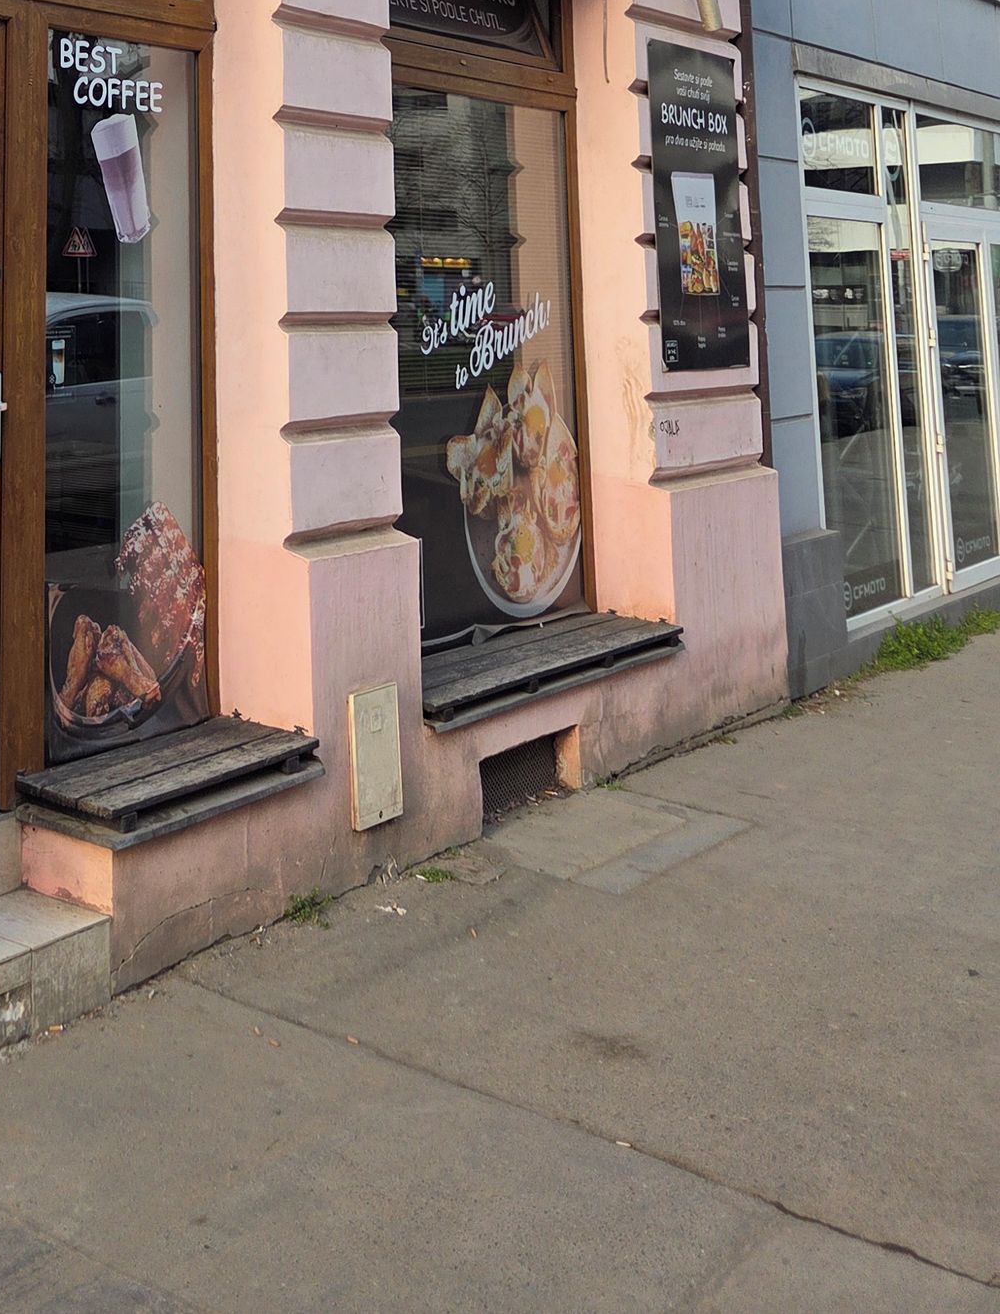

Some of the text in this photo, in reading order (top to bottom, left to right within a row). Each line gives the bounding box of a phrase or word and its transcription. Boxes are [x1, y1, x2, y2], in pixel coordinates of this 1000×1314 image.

[433, 0, 468, 22] PODLE
[60, 38, 123, 75] BEST
[73, 77, 163, 113] COFFEE
[661, 102, 728, 135] BRUNCH BOX
[449, 281, 496, 337] time
[469, 292, 550, 377] Brunch!
[455, 364, 469, 389] to
[966, 536, 991, 554] CFMOTO
[853, 577, 886, 600] CFMOTO
